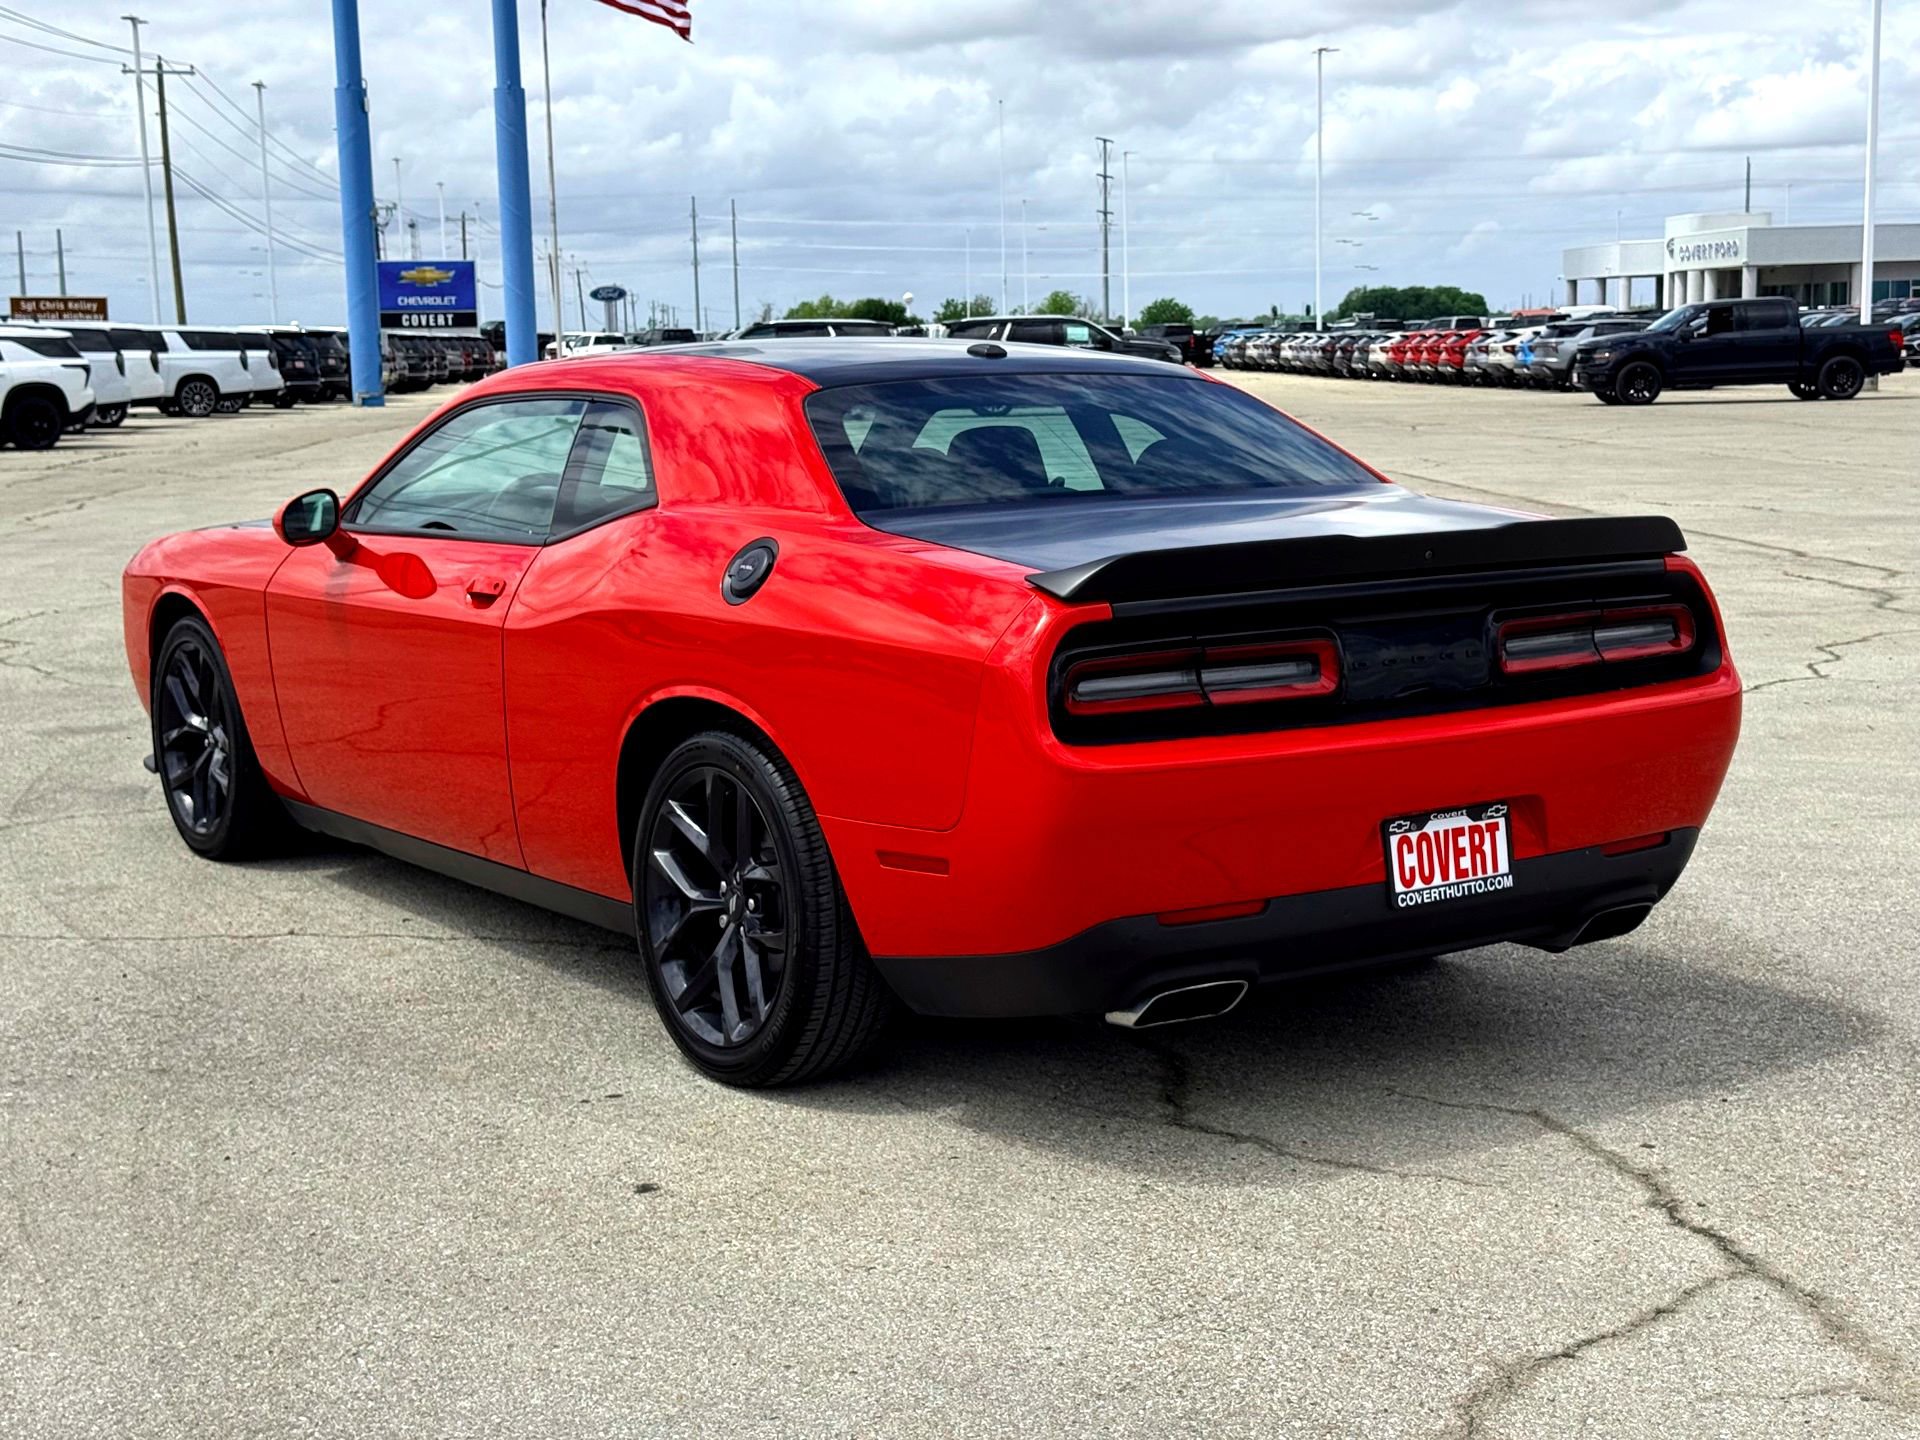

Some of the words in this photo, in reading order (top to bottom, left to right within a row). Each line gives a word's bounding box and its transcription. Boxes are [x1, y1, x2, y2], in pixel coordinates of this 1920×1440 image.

[20, 300, 36, 312] Sgt
[39, 300, 65, 311] Chris
[67, 300, 98, 312] Kelley
[397, 296, 456, 306] CHEVROLET
[401, 314, 454, 327] COVERT
[1430, 809, 1468, 820] Covert
[1396, 821, 1500, 889] COVERT
[1397, 875, 1514, 908] COVERTHUTTO.COM
